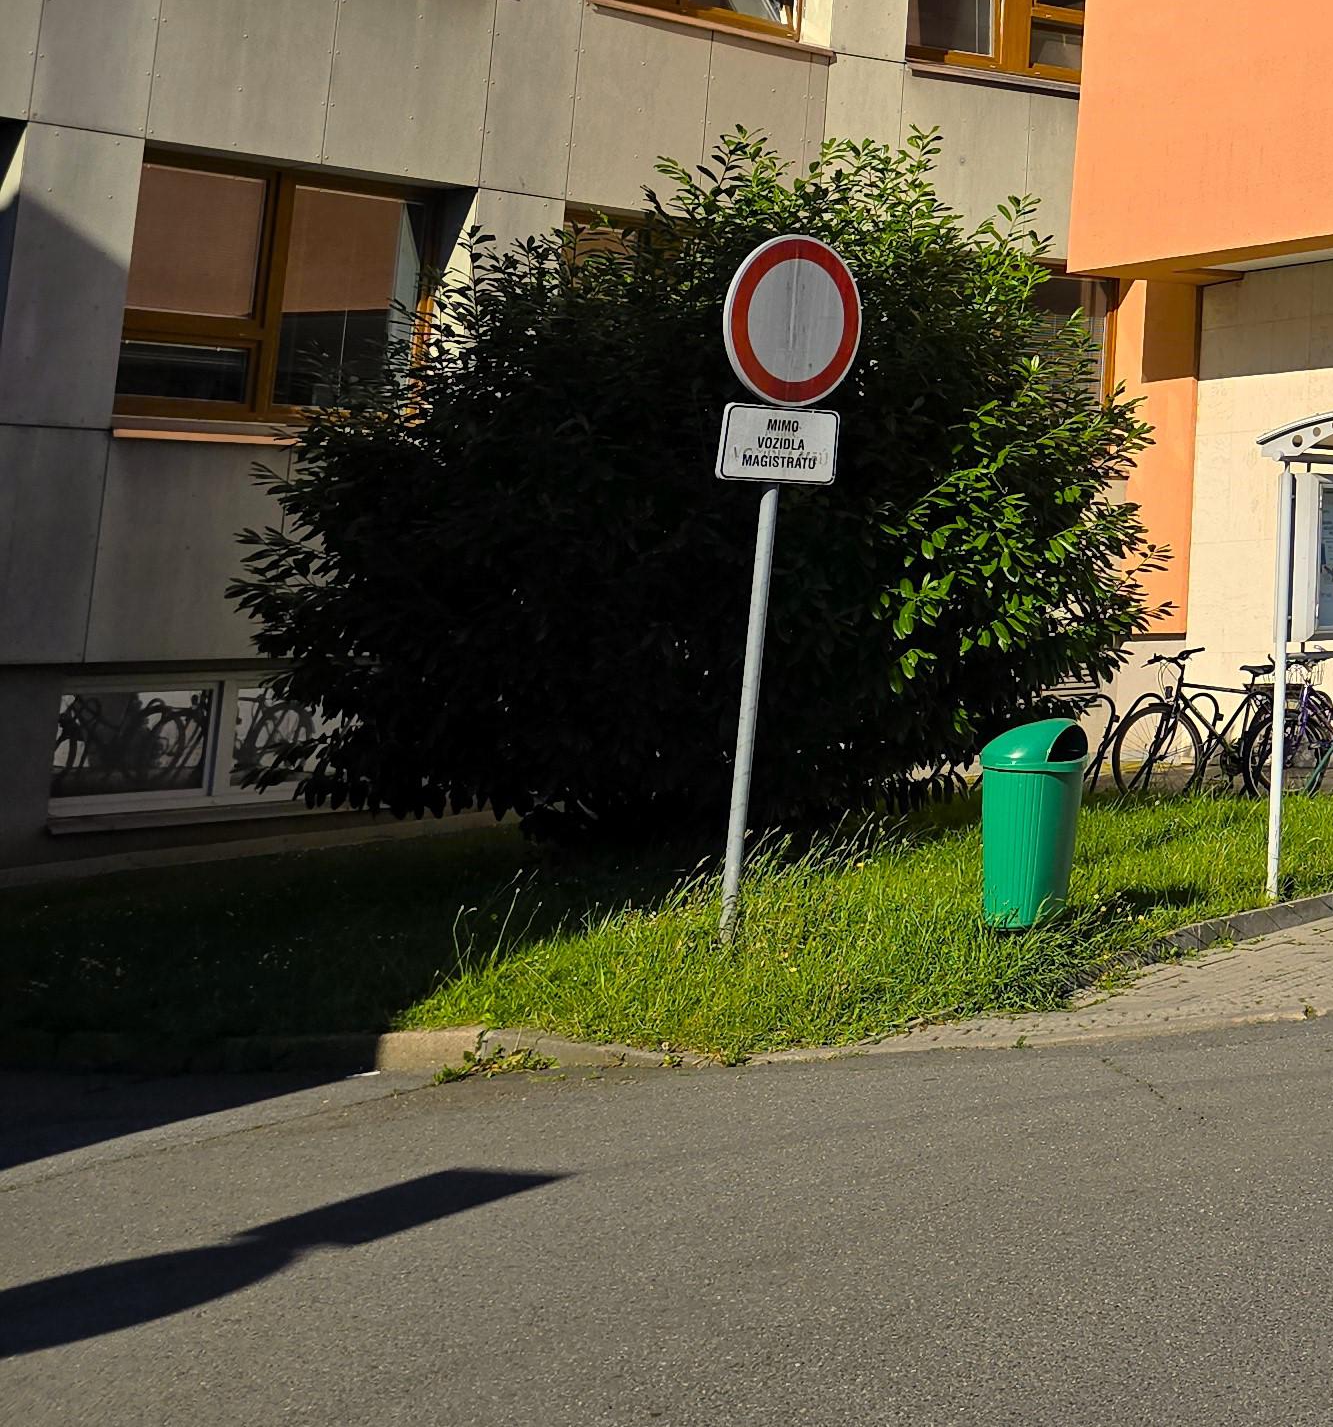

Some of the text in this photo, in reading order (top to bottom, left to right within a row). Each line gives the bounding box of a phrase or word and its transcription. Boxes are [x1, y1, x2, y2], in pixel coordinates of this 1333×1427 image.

[767, 419, 799, 432] MIMO
[757, 436, 805, 450] VOZIDLA
[742, 454, 817, 469] MAGISTRÁTU
